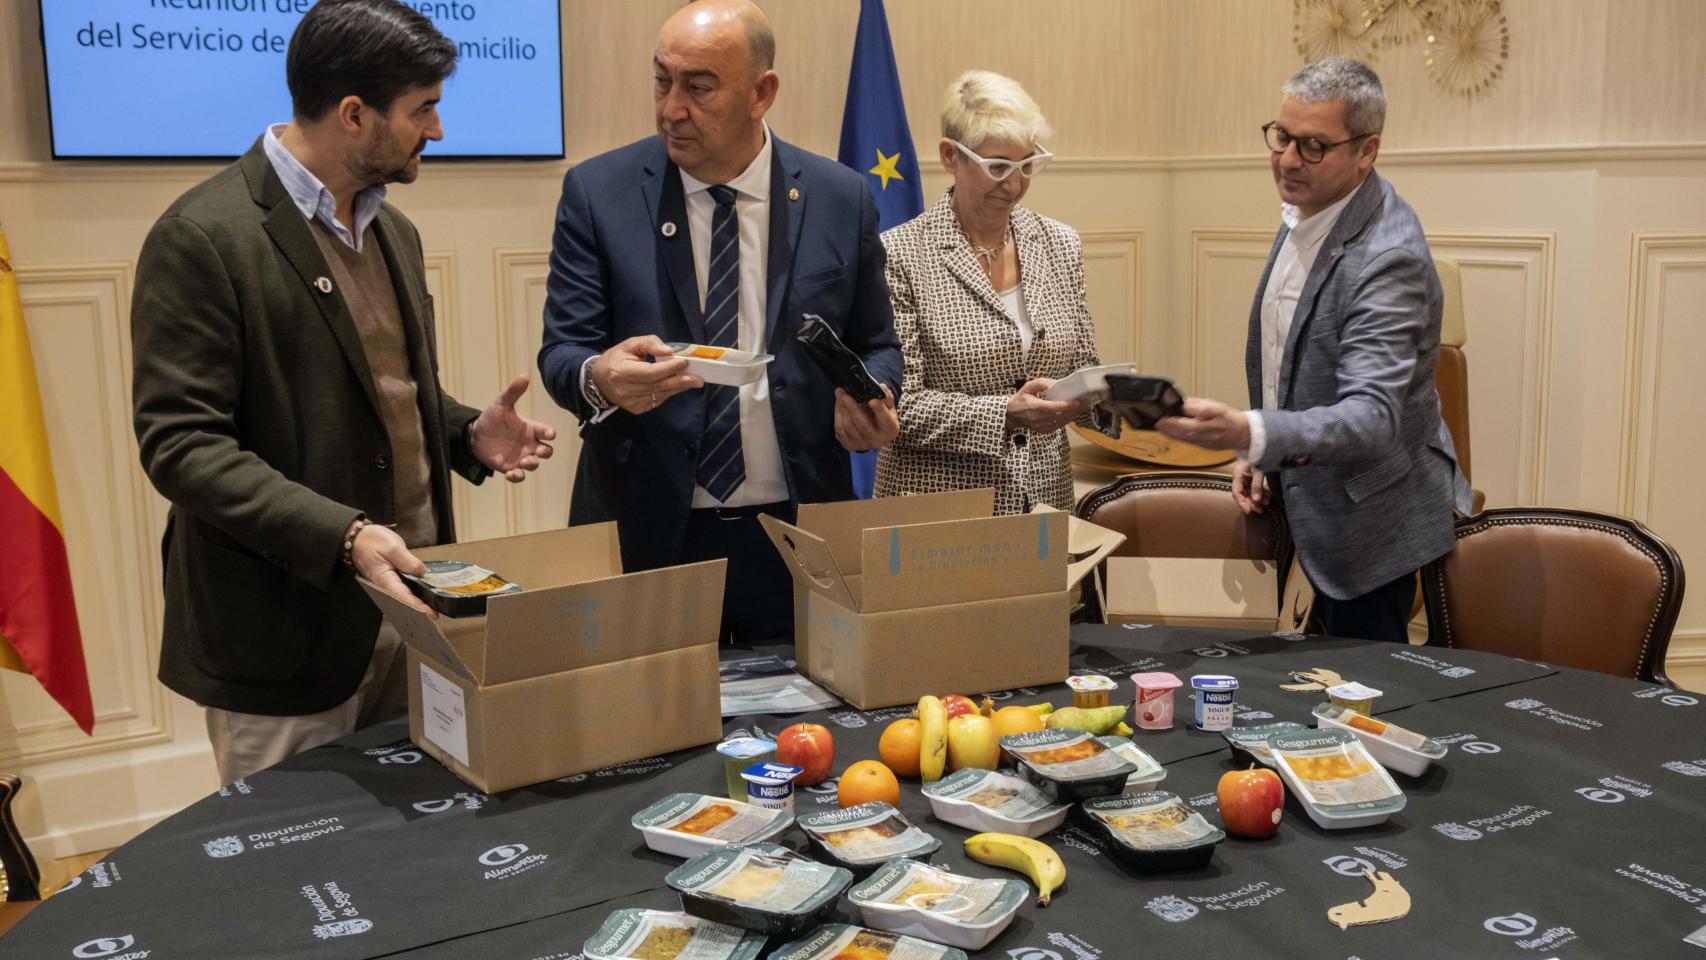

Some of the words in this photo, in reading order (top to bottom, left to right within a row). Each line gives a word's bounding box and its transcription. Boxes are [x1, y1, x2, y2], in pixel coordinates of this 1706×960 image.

[76, 21, 122, 48] del
[132, 24, 243, 52] Servicio
[251, 28, 286, 53] de
[1206, 693, 1232, 702] Nestlé
[1276, 735, 1340, 750] Gesgourmet
[760, 785, 789, 798] Nestlé
[247, 816, 340, 842] Diputación
[252, 840, 277, 850] de
[279, 824, 345, 845] Segovia
[676, 856, 728, 887] Gesgourmet
[854, 867, 901, 899] Gesgourmet
[1224, 887, 1287, 910] Segovia
[593, 918, 635, 955] Gesgourmet
